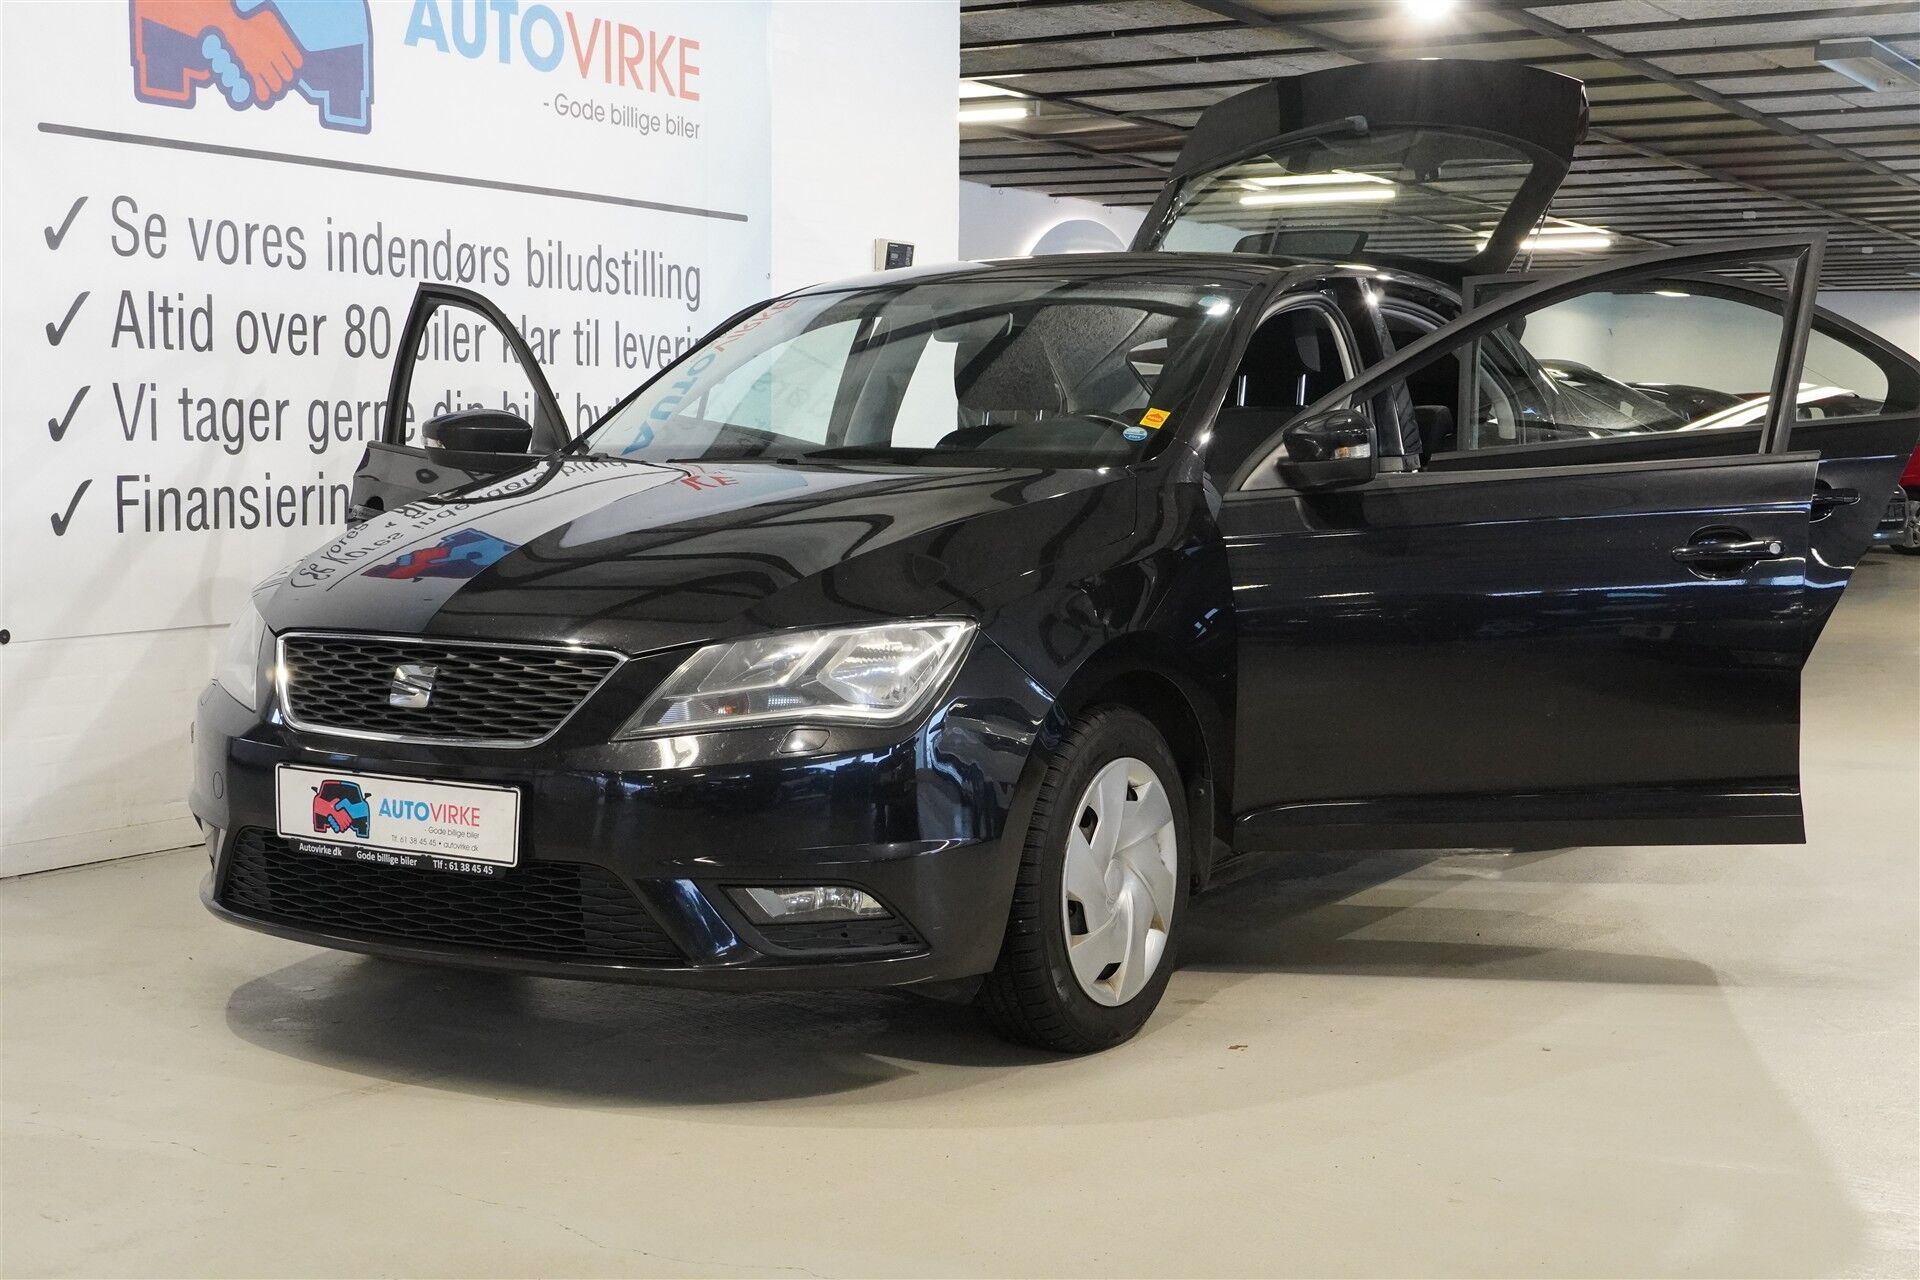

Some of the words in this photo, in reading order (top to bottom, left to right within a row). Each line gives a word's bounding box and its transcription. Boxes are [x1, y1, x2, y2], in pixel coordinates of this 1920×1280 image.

[404, 0, 699, 101] AUTOVIRKE
[554, 93, 605, 122] Gode
[610, 103, 660, 136] billige
[665, 114, 700, 139] biler
[111, 195, 167, 259] Se
[188, 217, 307, 270] vores
[326, 216, 509, 286] indendørs
[527, 237, 700, 312] biludstilling
[111, 290, 213, 352] Altid
[236, 309, 327, 356] over
[344, 303, 391, 360] 80
[573, 318, 600, 366] til
[615, 320, 700, 369] leveri
[112, 382, 157, 441] Vi
[178, 387, 290, 455] tager
[378, 798, 480, 827] AUTOVIRKE
[428, 826, 446, 836] Gode
[447, 828, 465, 839] billige
[466, 831, 480, 839] biler
[356, 850, 375, 861] Gode
[377, 852, 398, 865] billige
[400, 856, 417, 867] biler
[433, 859, 443, 869] Tlf
[449, 861, 459, 871] 61
[460, 862, 470, 872] 38
[472, 864, 482, 874] 45
[483, 865, 493, 875] 45
[400, 835, 408, 843] 61
[409, 836, 417, 845] 38
[419, 838, 428, 846] 45
[429, 839, 437, 847] 45
